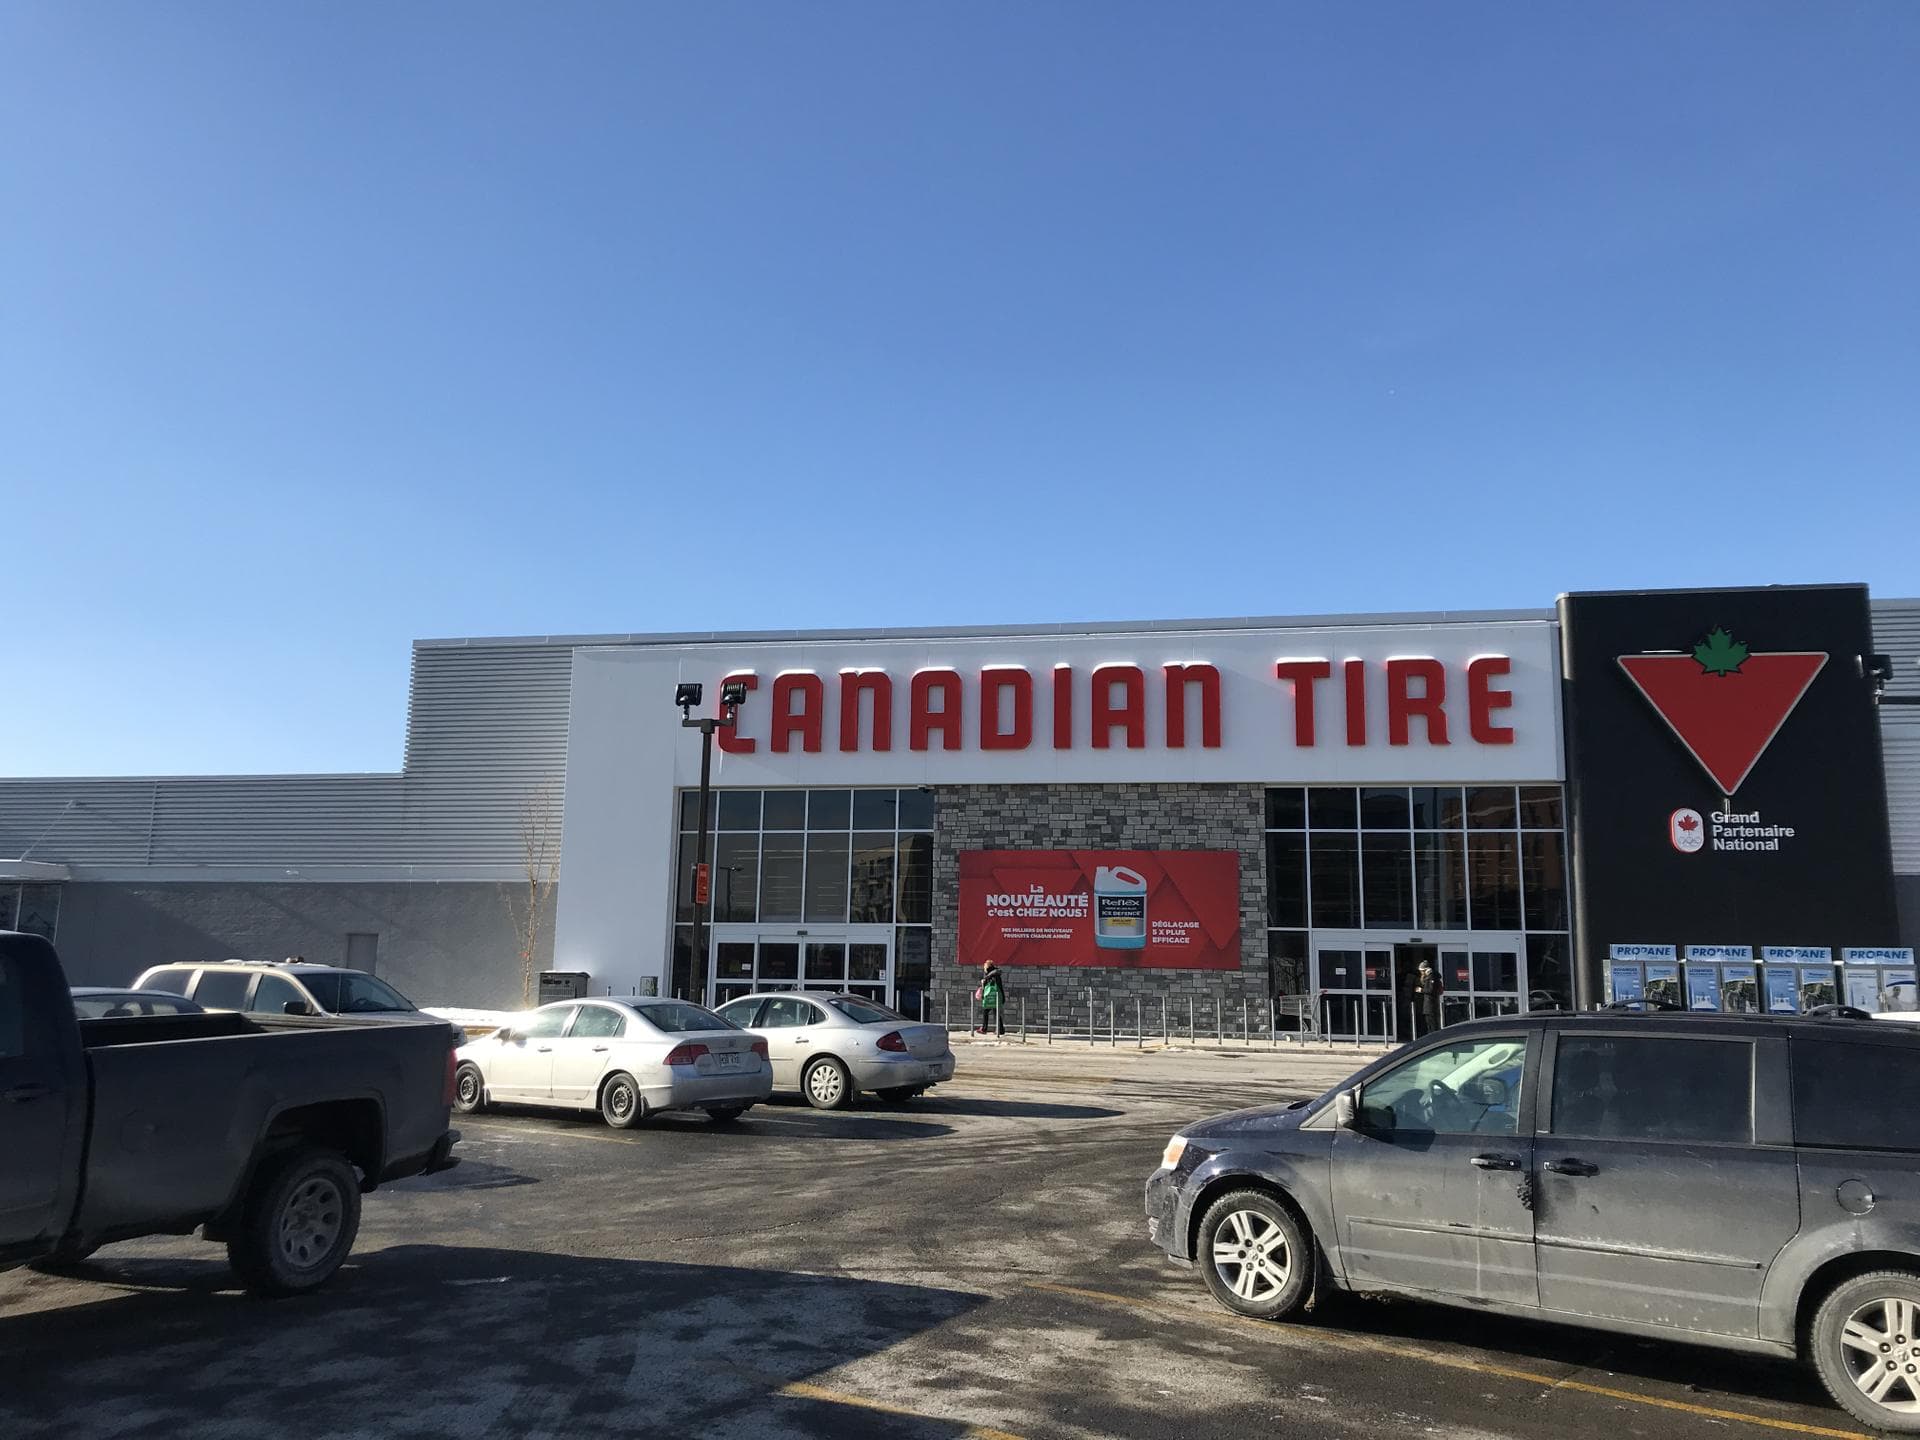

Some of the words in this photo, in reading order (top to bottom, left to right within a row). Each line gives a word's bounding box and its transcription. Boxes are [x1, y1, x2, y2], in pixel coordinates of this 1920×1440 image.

[718, 663, 1221, 753] CANADIAN
[1276, 657, 1514, 746] TIRE
[1711, 811, 1760, 823] Grand
[1713, 825, 1795, 837] Partenaire
[1713, 838, 1780, 851] National
[1030, 884, 1044, 893] La
[986, 892, 1089, 907] NOUVEAUTÉ
[1016, 908, 1047, 917] CHEZ
[1152, 920, 1200, 929] DÉGLAÇAGE
[1152, 936, 1191, 944] EFFICACE
[1617, 946, 1671, 956] PROPANE
[1770, 949, 1826, 958] PROPANE
[1850, 950, 1908, 960] PROPANE
